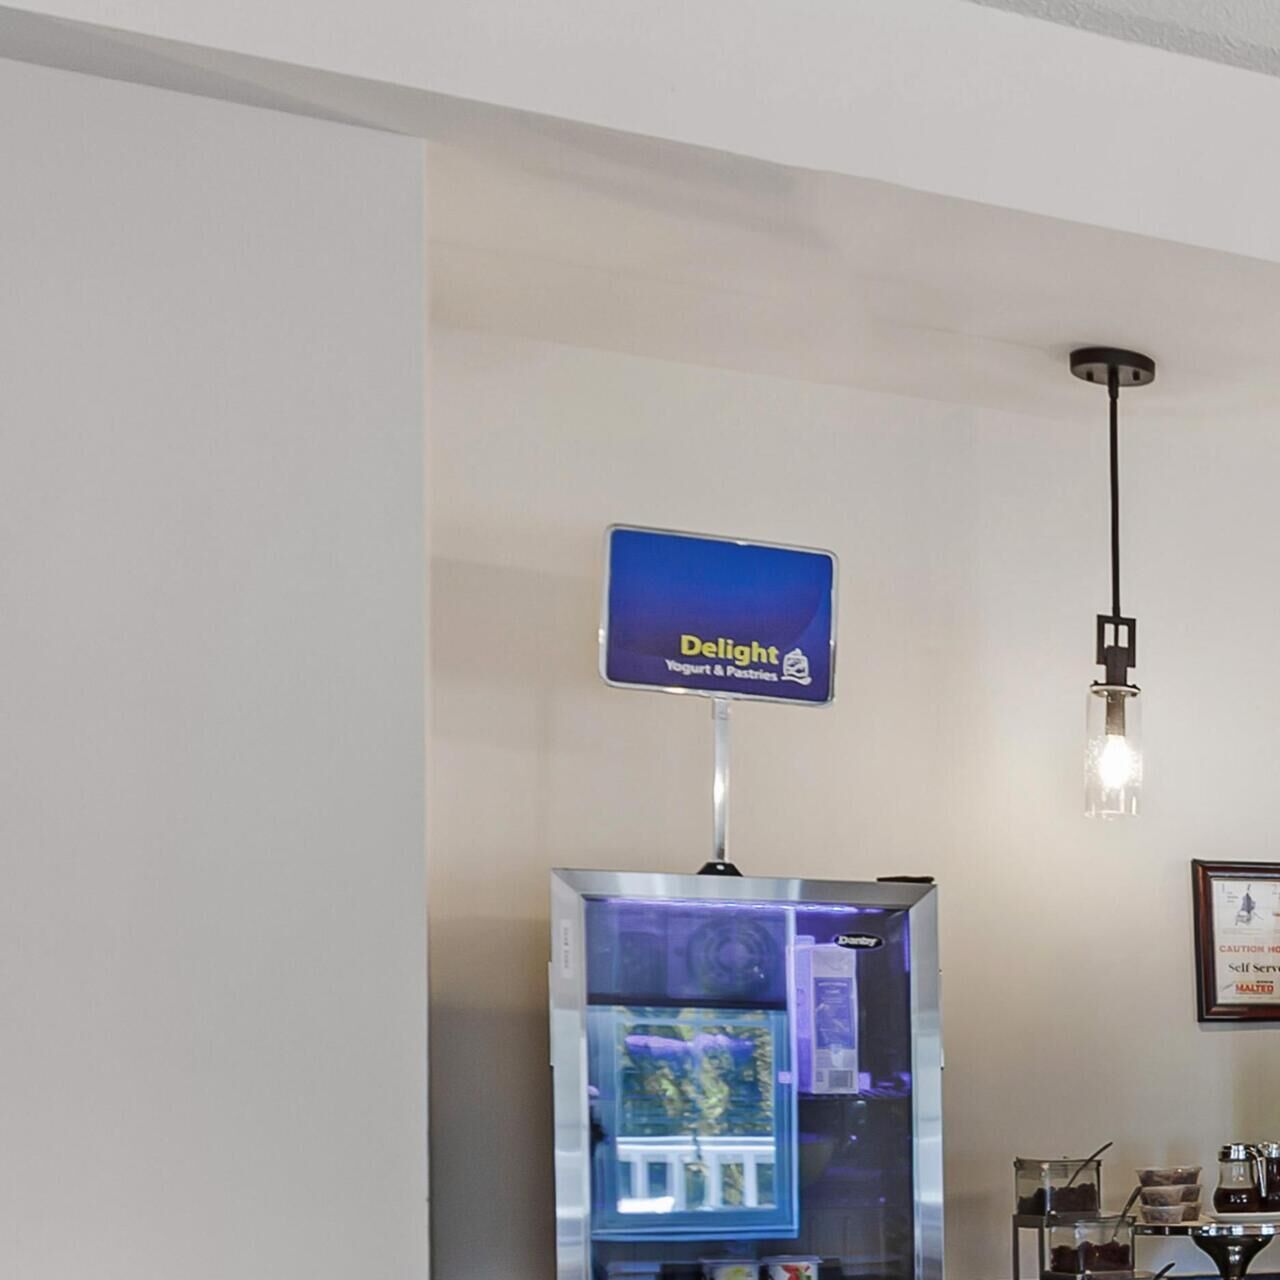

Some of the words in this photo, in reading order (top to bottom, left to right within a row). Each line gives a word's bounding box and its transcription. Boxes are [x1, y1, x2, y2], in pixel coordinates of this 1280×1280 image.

[680, 634, 779, 666] Delight
[665, 659, 711, 676] Yogurt
[713, 664, 724, 677] &
[726, 666, 779, 682] Pastries
[837, 935, 879, 947] Danby
[1219, 945, 1265, 953] CAUTION
[1228, 962, 1250, 973] Self
[1235, 984, 1275, 993] MALTED
